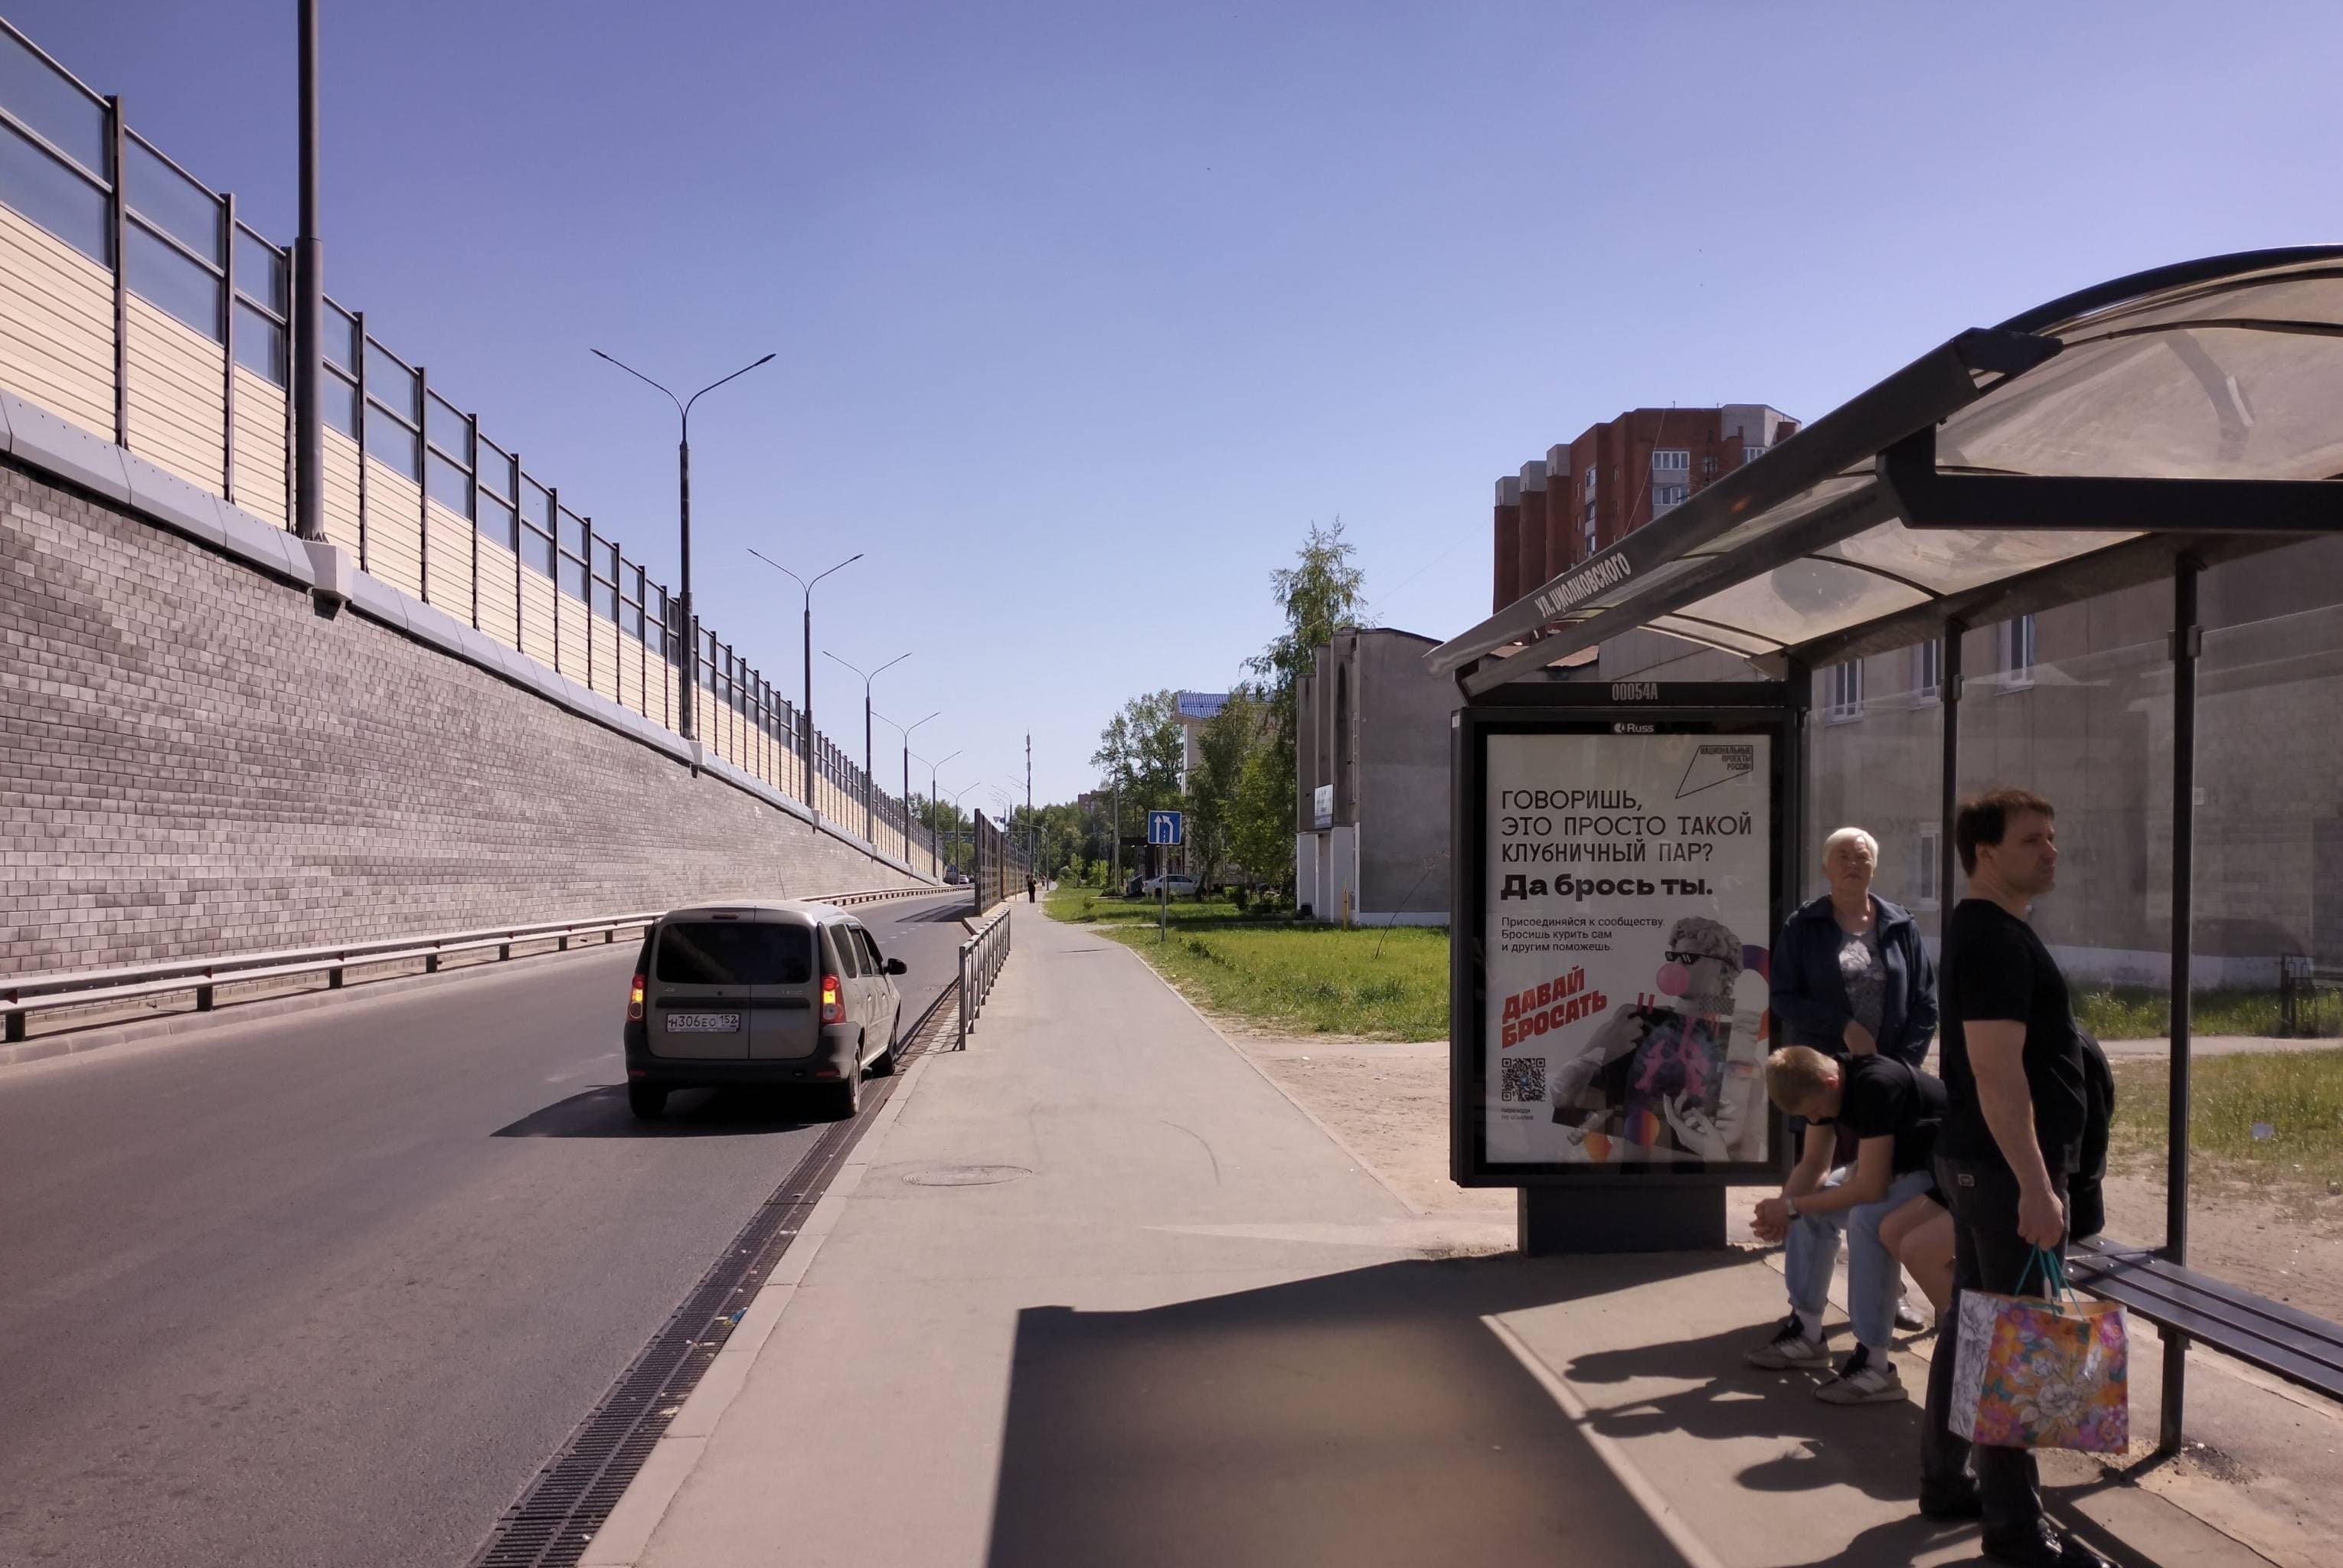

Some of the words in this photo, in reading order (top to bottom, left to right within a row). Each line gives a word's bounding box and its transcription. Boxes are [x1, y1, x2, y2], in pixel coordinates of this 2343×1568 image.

[1534, 596, 1555, 618] УЛ.
[1549, 552, 1631, 612] ЦИОЛКОВСКОГО
[1627, 723, 1654, 733] Russ
[1502, 789, 1642, 812] ГОВОРИШЬ,
[1502, 816, 1552, 836] ЭТО
[1564, 815, 1666, 836] ПРОСТО
[1677, 812, 1752, 835] ТАКОЙ
[1659, 842, 1713, 862] ПАР?
[1500, 874, 1548, 900] Да
[1554, 873, 1655, 902] брось
[1660, 879, 1713, 896] ты.
[1502, 917, 1586, 929] Присоединяйся
[1598, 916, 1665, 930] сообществу.
[1502, 929, 1551, 942] Бросишь
[1553, 932, 1589, 942] курить
[1511, 943, 1550, 954] другим
[1552, 943, 1613, 952] поможешь.
[1502, 965, 1585, 1025] ДАВАЙ
[719, 1015, 737, 1024] 152
[1502, 990, 1608, 1049] БРОСАТЬ
